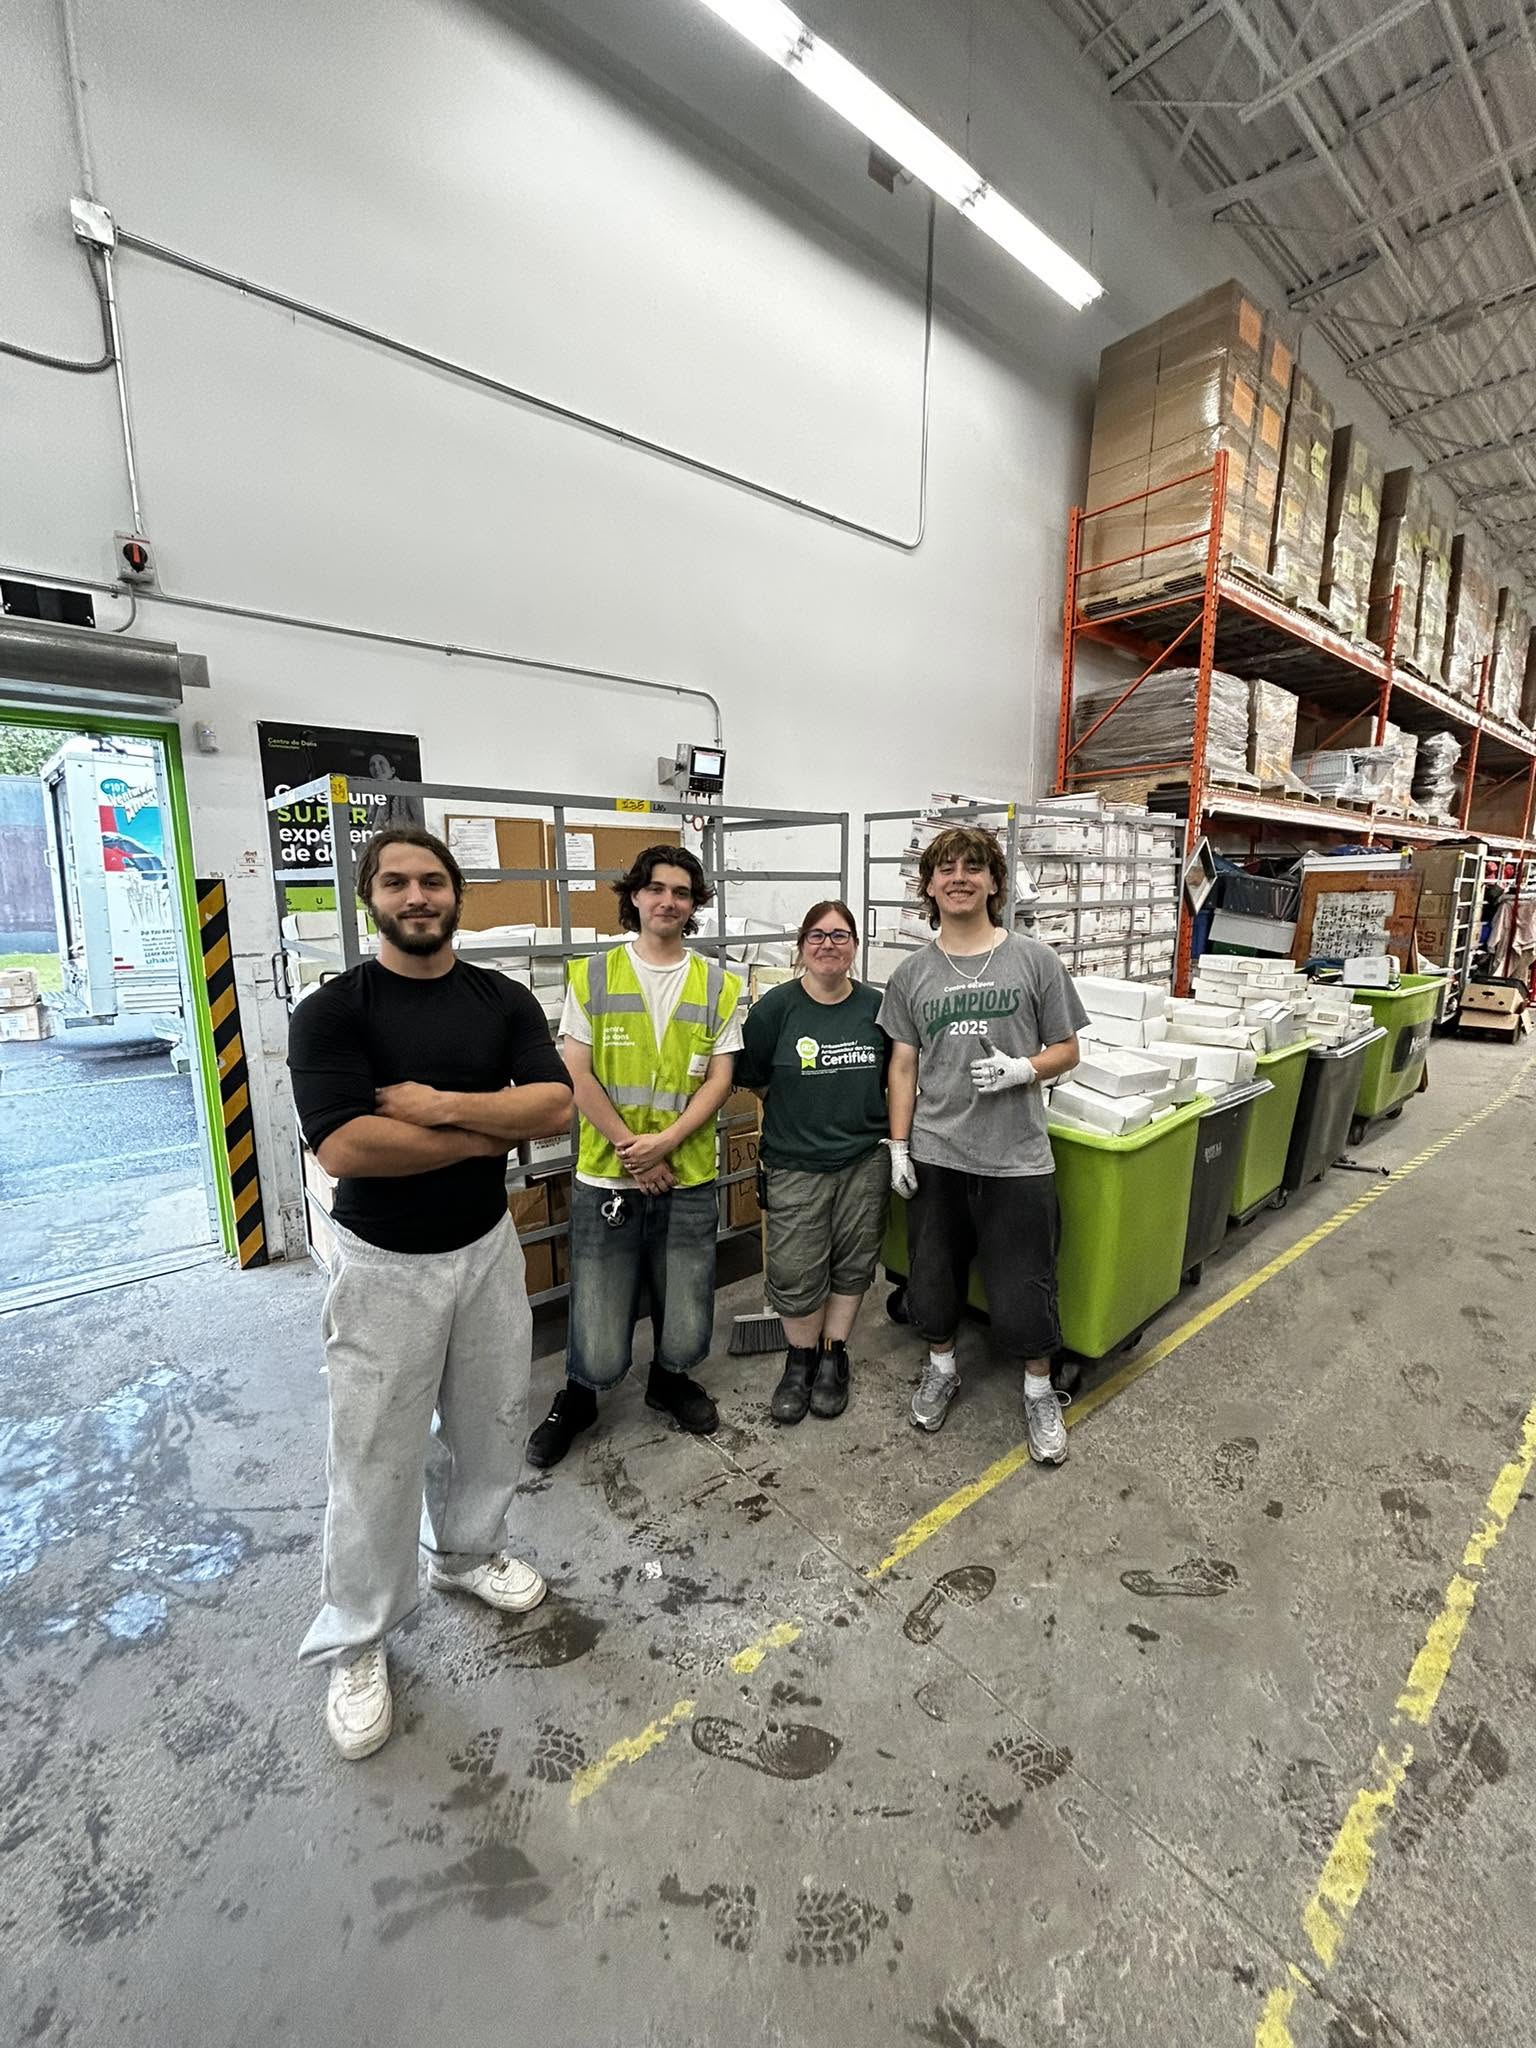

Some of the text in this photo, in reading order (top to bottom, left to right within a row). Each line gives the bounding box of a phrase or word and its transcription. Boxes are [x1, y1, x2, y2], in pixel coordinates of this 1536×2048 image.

[348, 792, 387, 806] une
[281, 844, 311, 861] de
[923, 988, 1021, 1022] CHAMPIONS
[949, 1020, 988, 1035] 2025
